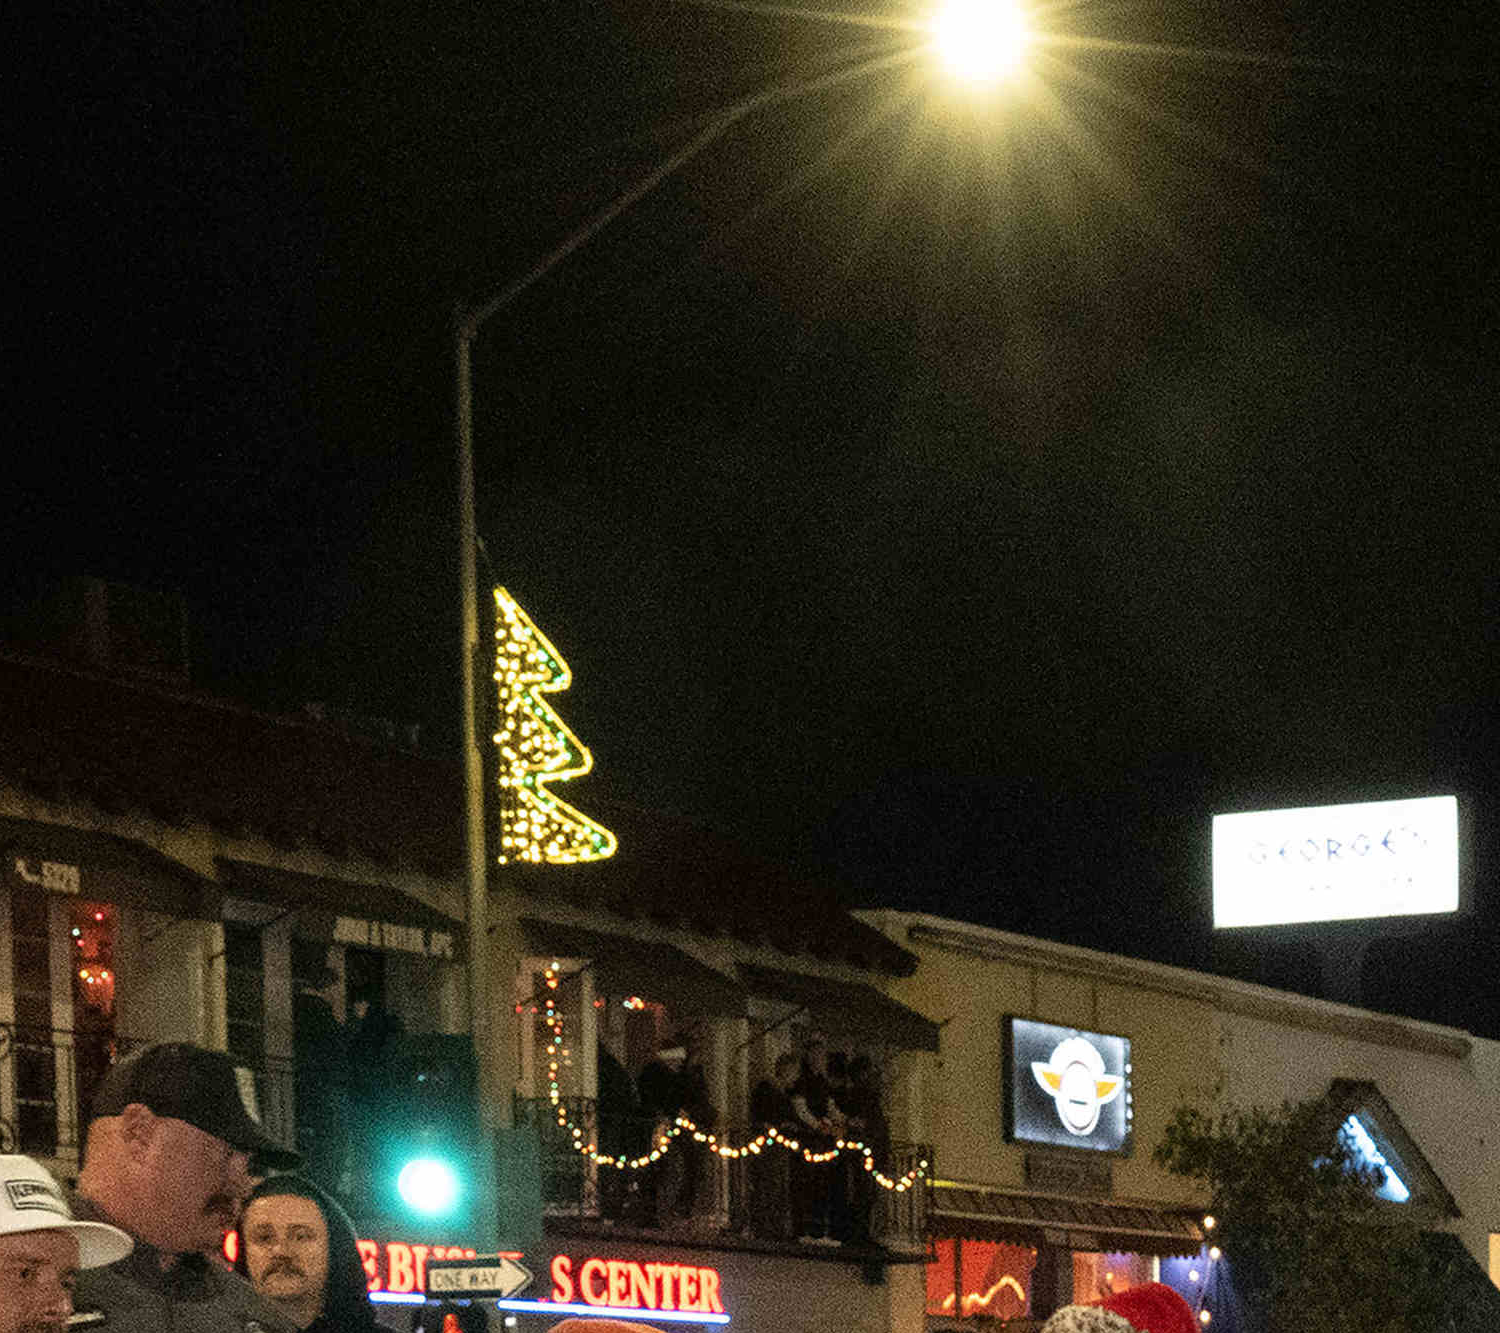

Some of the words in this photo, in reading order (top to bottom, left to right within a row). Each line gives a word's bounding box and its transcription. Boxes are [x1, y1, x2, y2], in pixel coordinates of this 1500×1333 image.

[434, 1272, 462, 1290] ONE
[468, 1270, 499, 1290] WAY
[579, 1257, 725, 1314] CENTER
